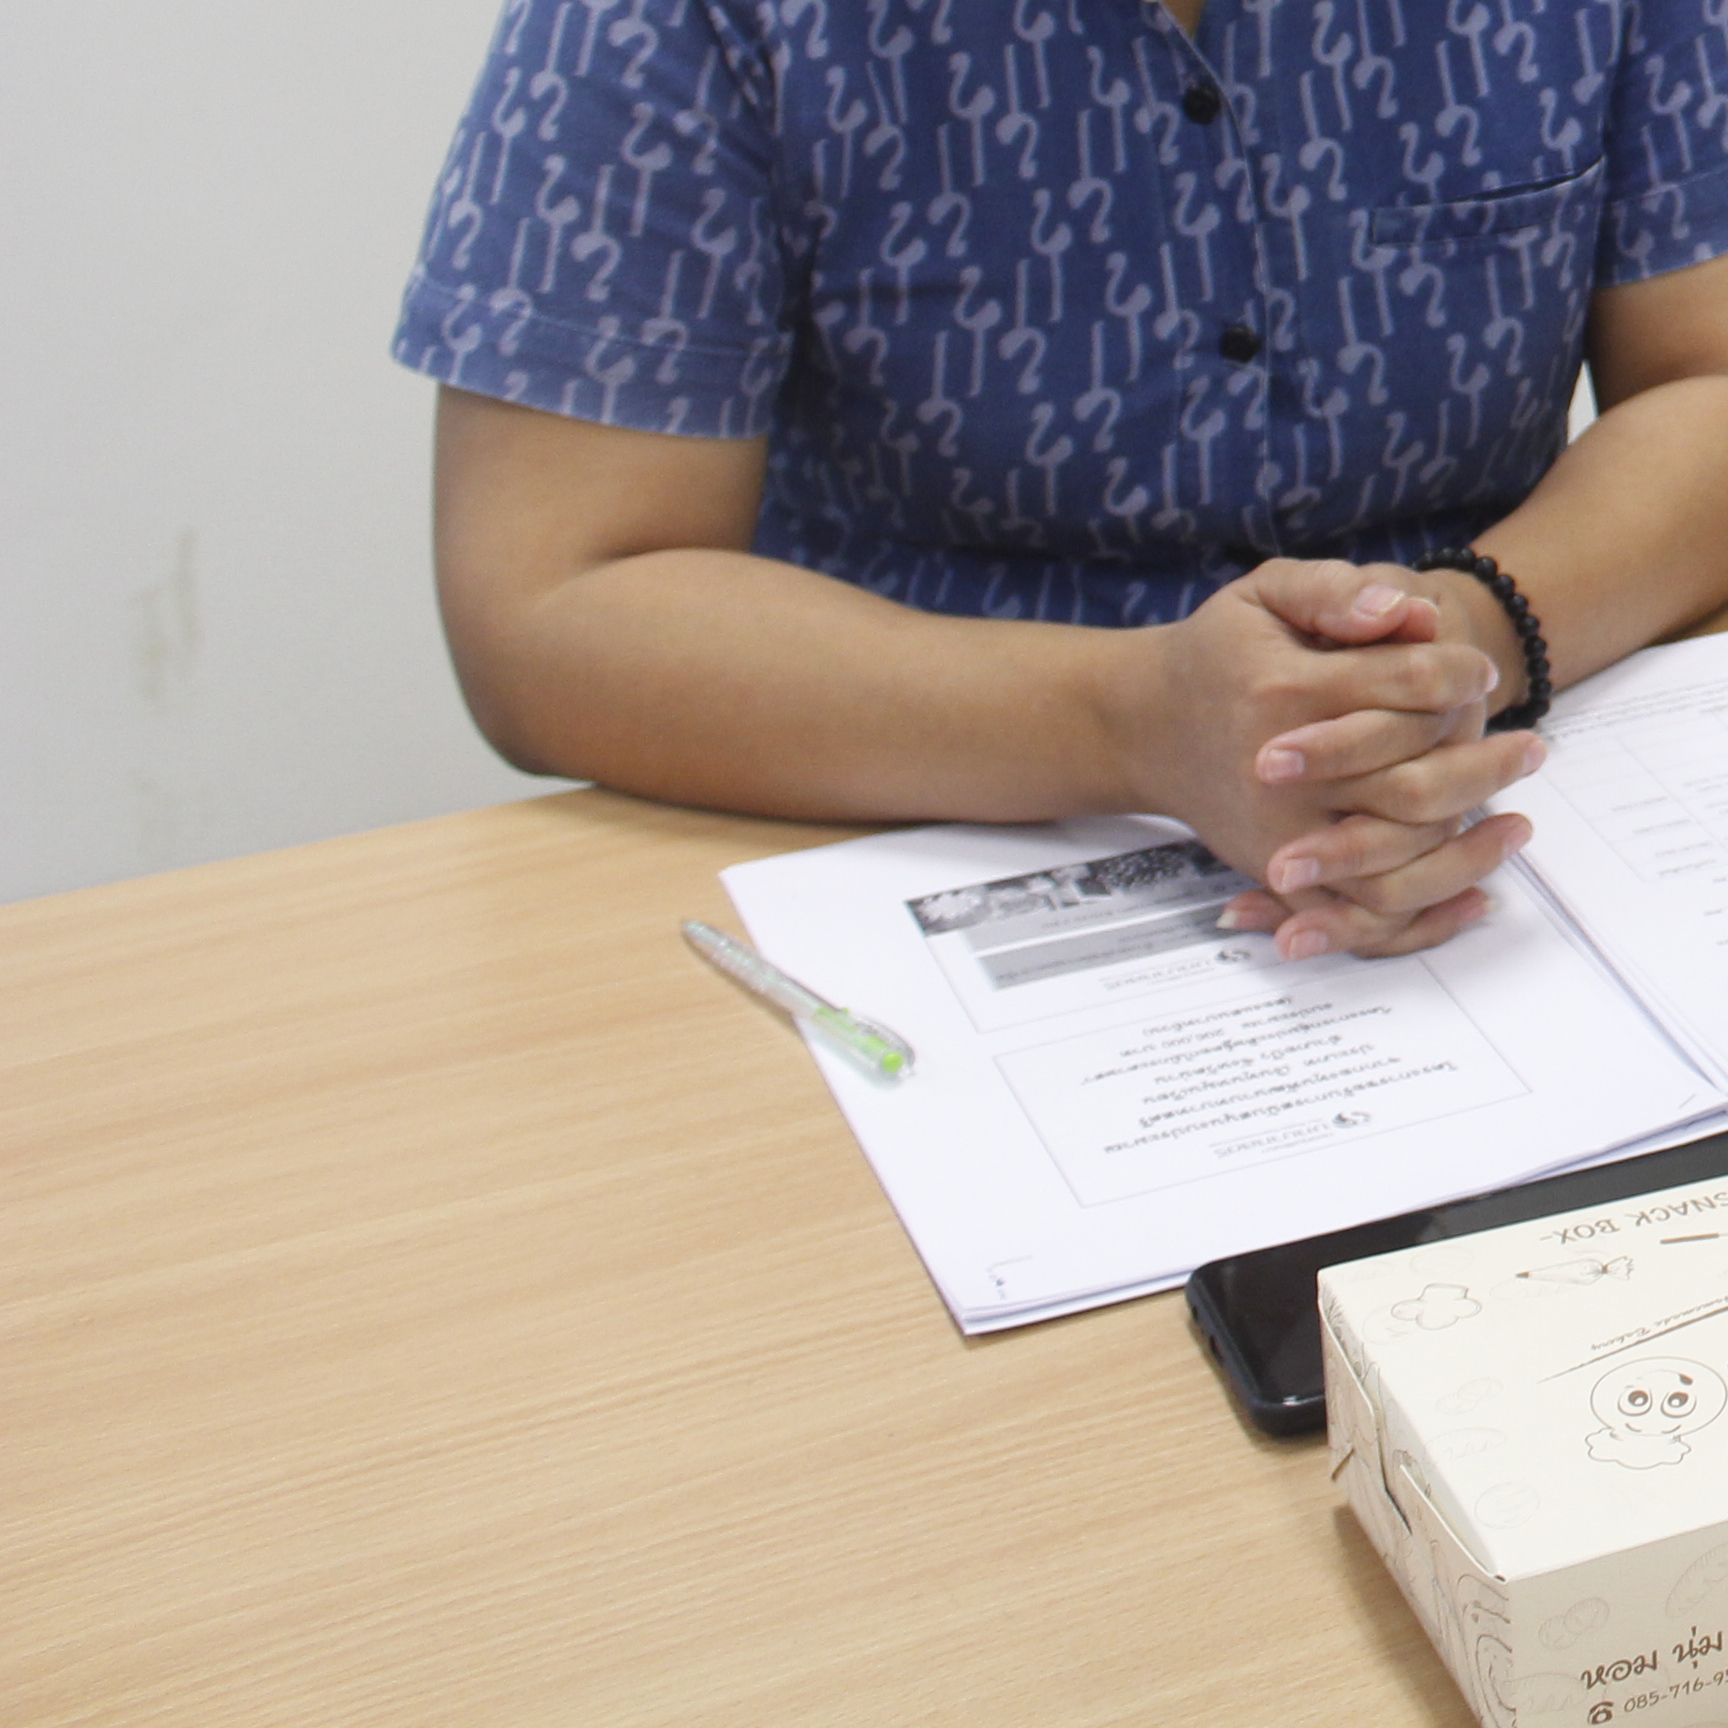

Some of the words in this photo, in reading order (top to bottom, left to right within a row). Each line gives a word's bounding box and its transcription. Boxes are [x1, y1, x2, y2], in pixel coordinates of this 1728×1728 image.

[1539, 1216, 1621, 1246] BOX-
[1590, 1327, 1652, 1352] Bakery
[1580, 1654, 1659, 1690] หอม
[1672, 1626, 1724, 1670] นุ่ม
